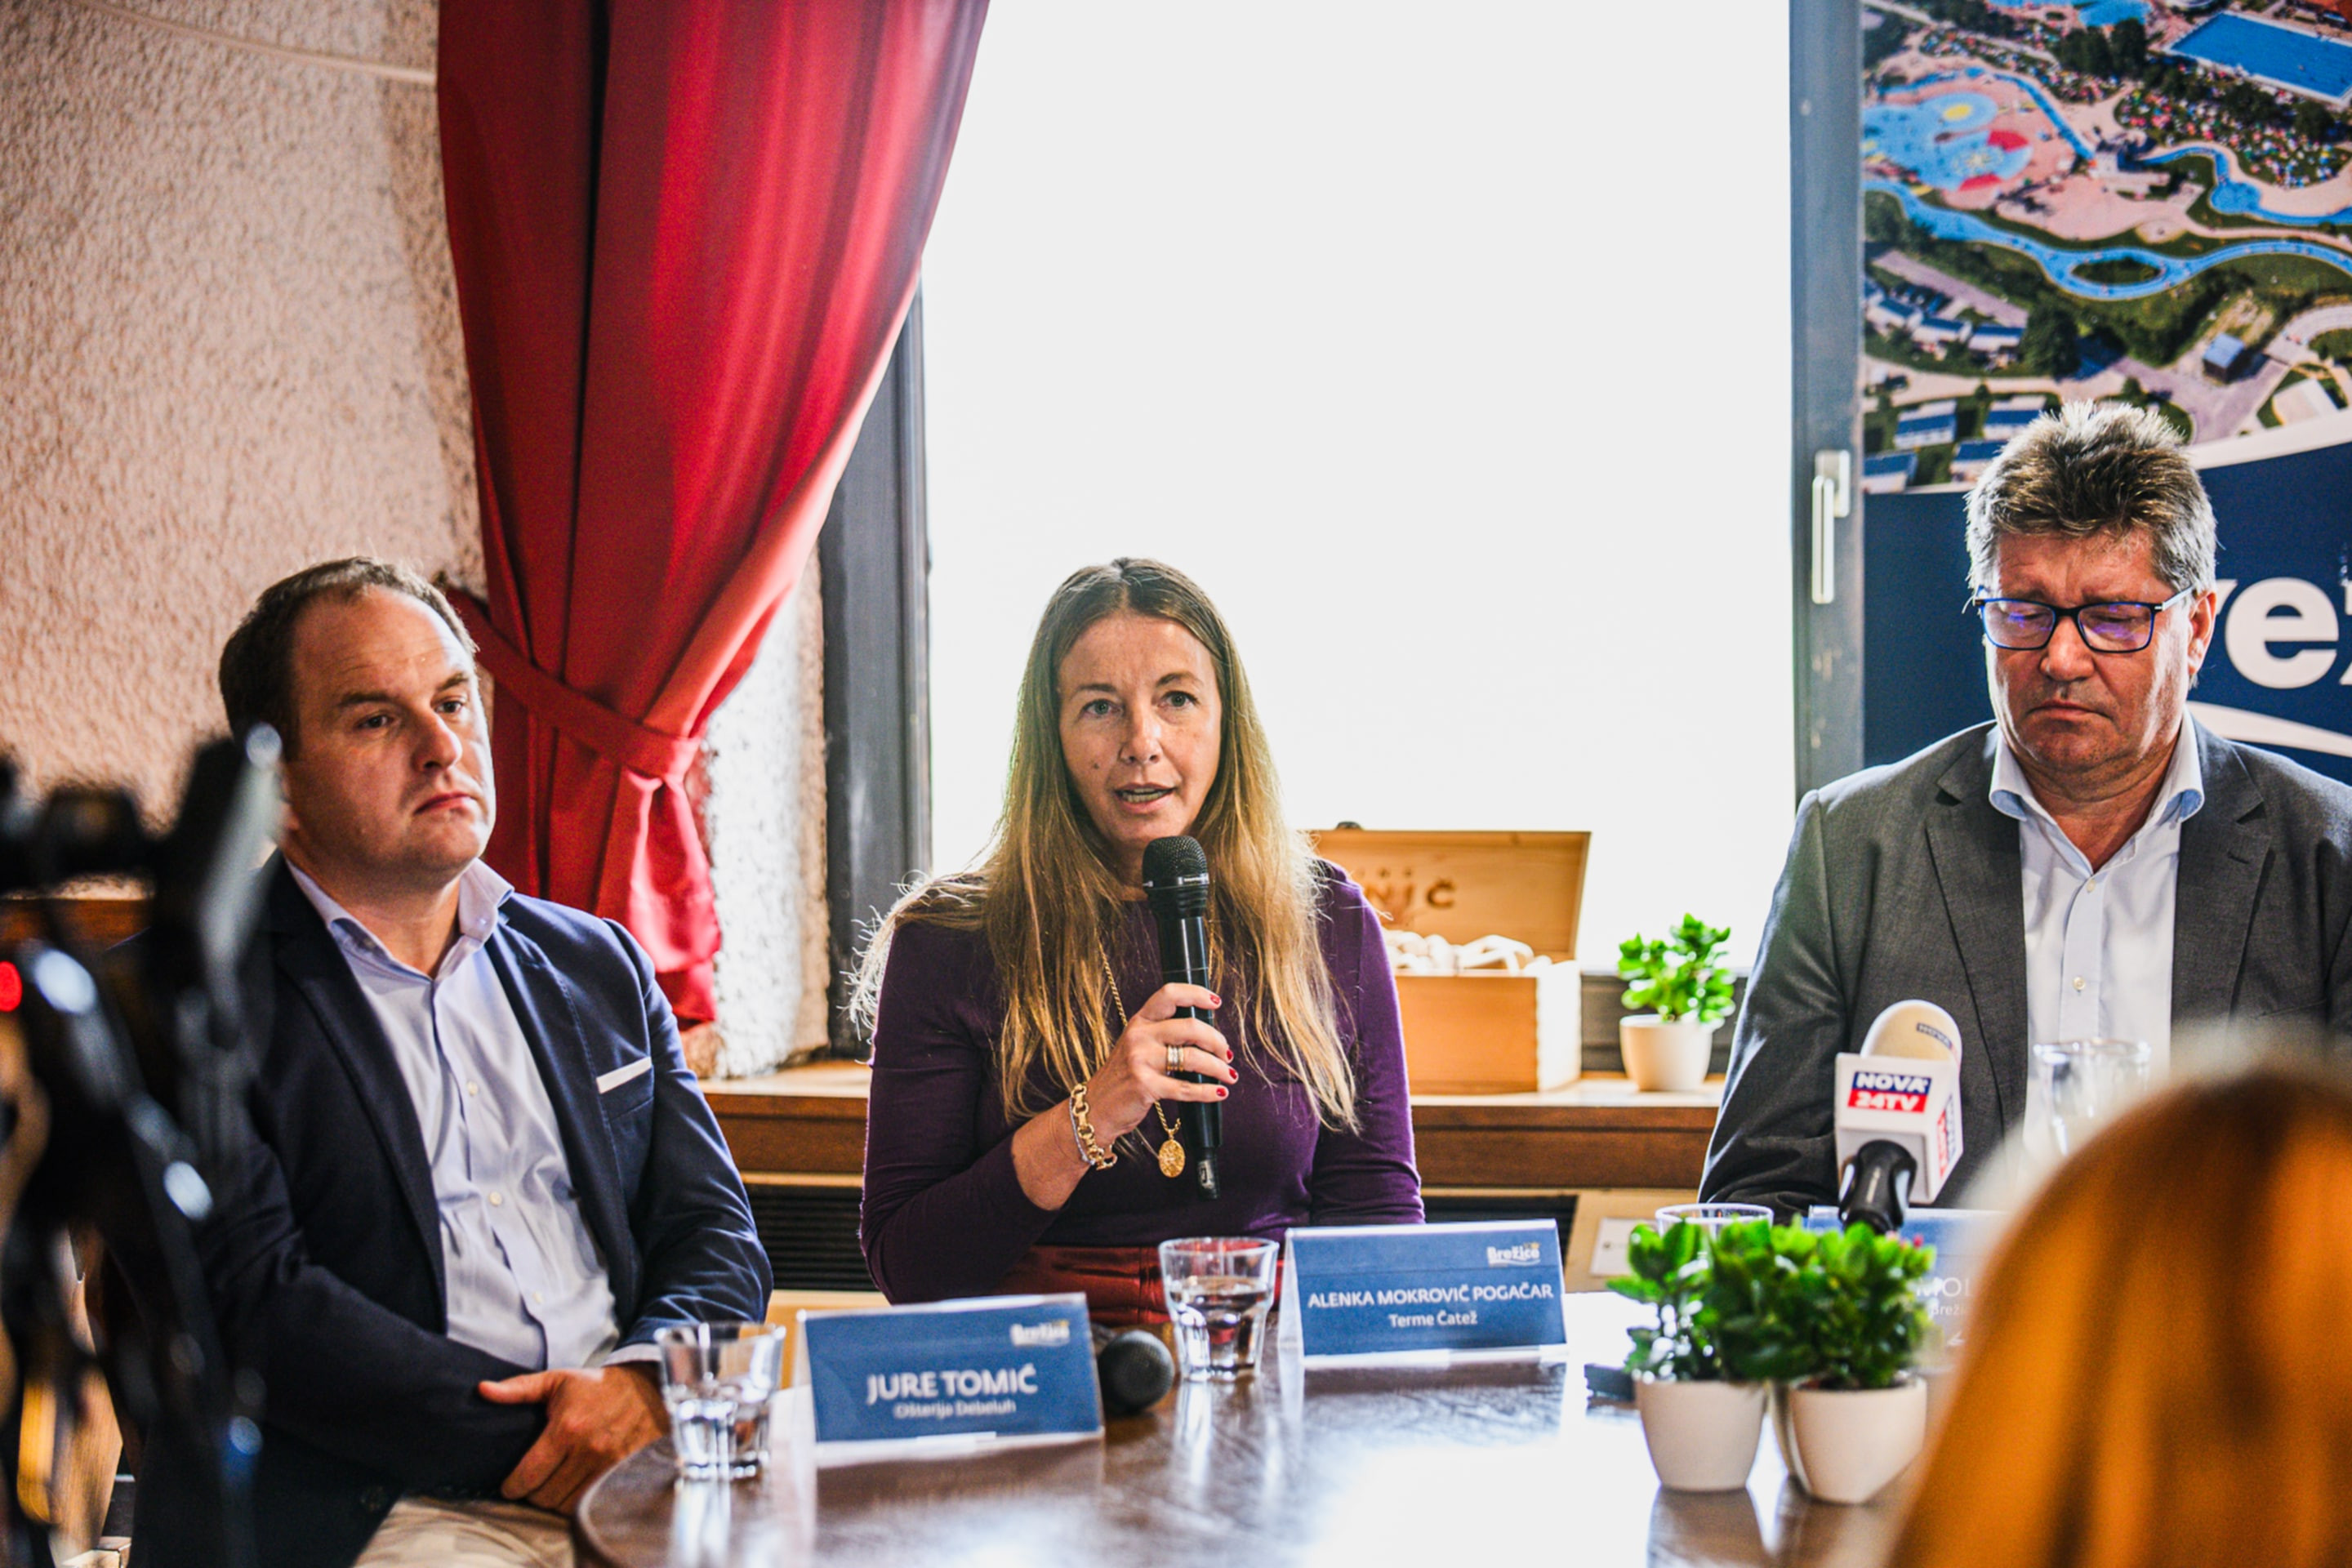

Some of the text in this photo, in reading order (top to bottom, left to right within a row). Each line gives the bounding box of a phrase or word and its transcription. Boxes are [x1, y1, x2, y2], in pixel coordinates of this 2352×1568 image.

[1855, 1072, 1928, 1094] NOVA
[1855, 1091, 1919, 1111] 24TV
[1308, 1282, 1554, 1309] ALENKA MOKROVIČ POGAČAR
[1389, 1310, 1478, 1329] Terme Čatež
[866, 1362, 1038, 1405] JURE TOMIĆ
